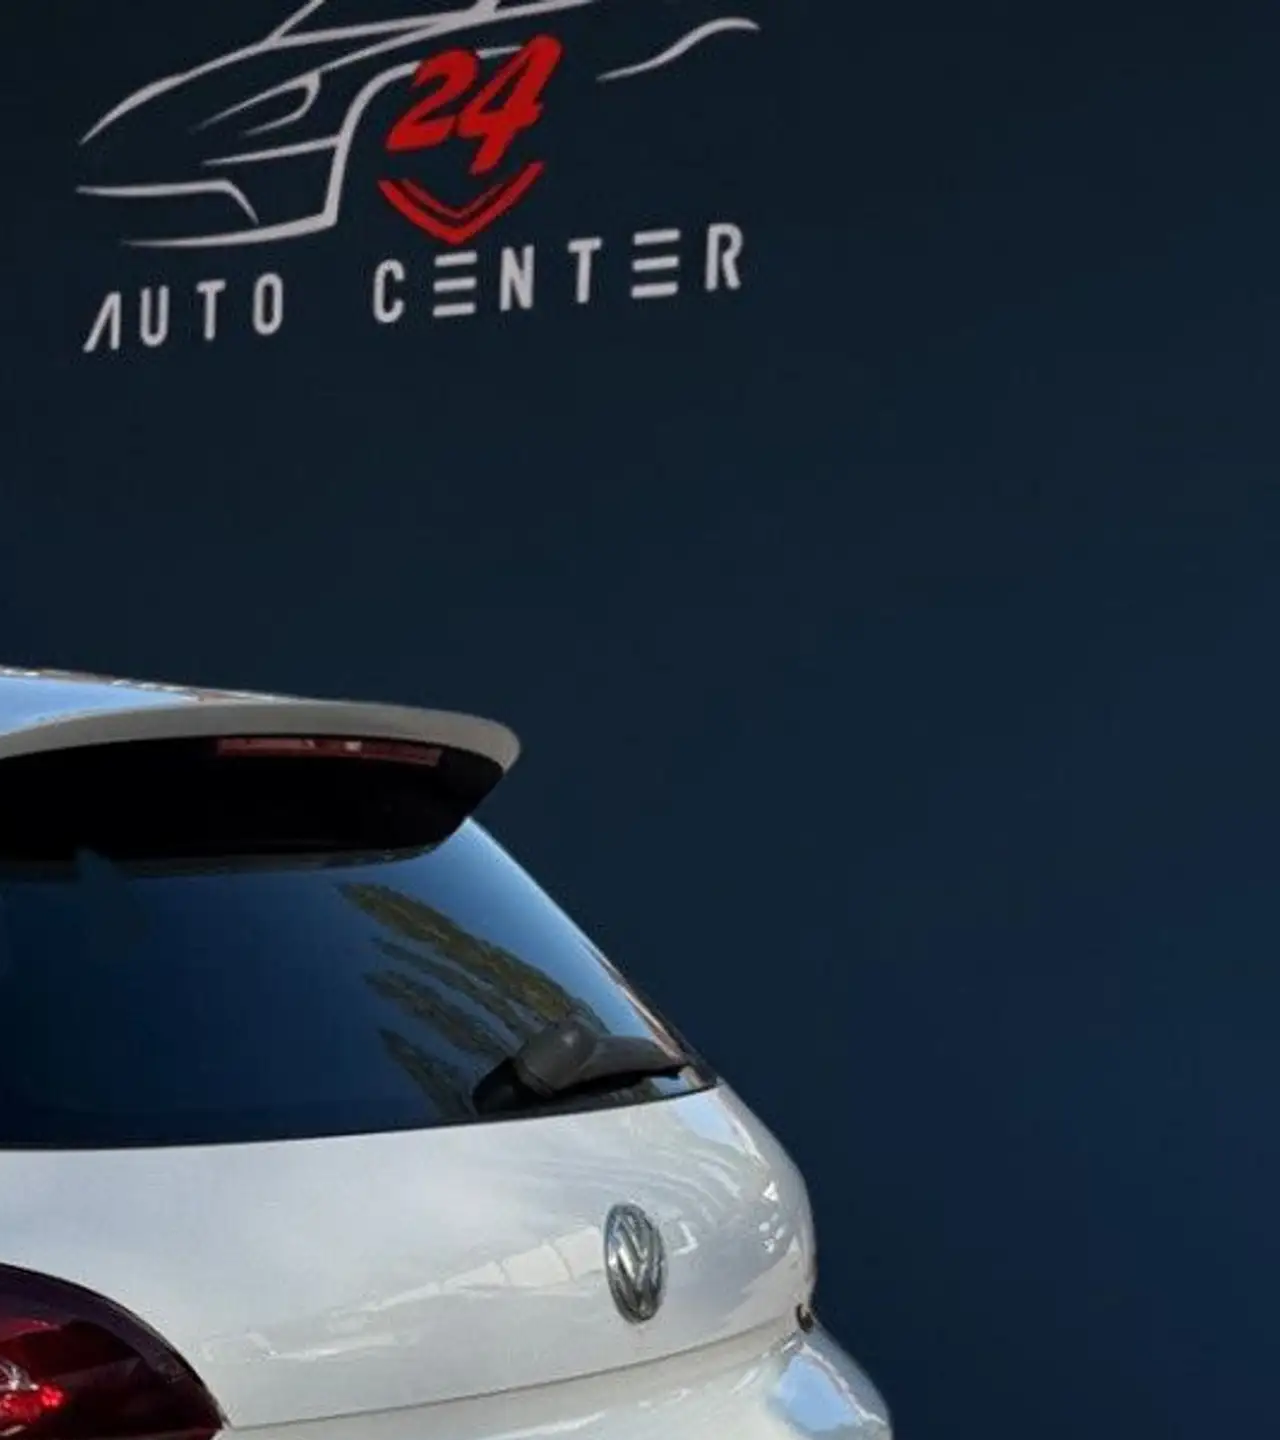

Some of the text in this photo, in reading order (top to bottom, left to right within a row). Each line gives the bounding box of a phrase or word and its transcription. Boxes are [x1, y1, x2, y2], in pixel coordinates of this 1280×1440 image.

[386, 34, 563, 175] 24
[83, 222, 744, 353] AUTO CENTER
